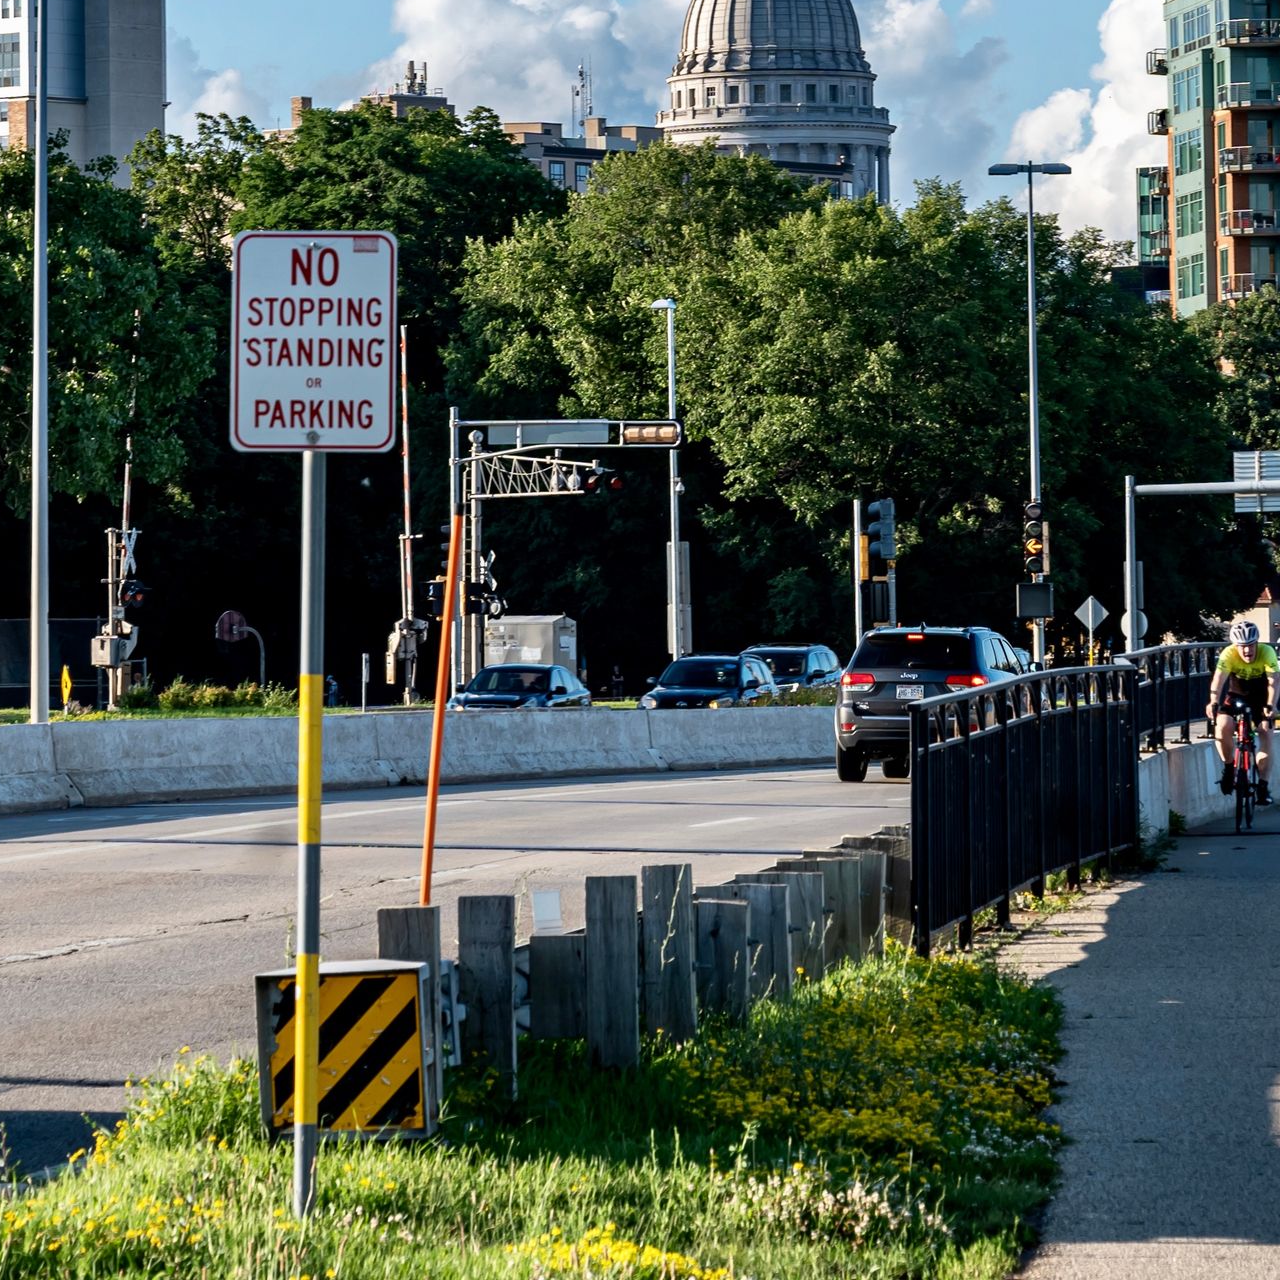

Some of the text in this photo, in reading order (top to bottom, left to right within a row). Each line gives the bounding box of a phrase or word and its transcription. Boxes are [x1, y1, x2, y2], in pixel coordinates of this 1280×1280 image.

[291, 248, 339, 286] NO
[247, 297, 383, 327] STOPPING
[245, 338, 383, 368] STANDING
[306, 377, 322, 388] OR
[254, 399, 373, 429] PARKING
[900, 672, 919, 680] Jeep
